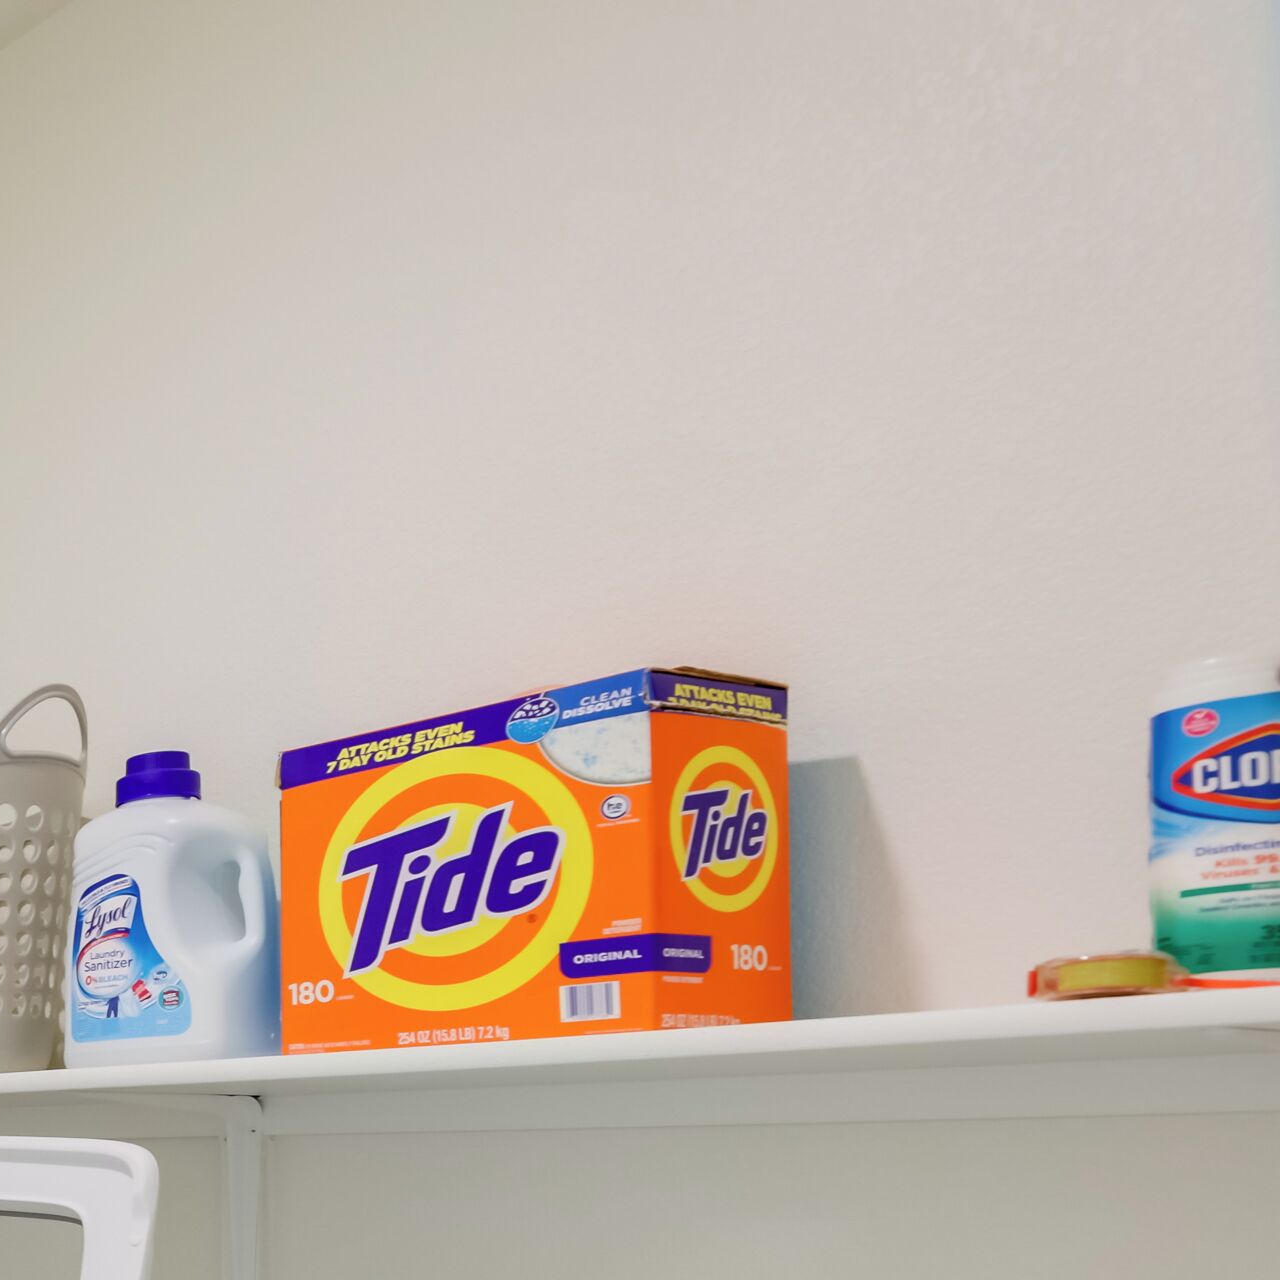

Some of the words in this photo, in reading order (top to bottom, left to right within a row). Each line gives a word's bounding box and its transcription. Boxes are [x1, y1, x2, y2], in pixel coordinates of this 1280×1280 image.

[562, 696, 632, 719] DISSOLVE
[580, 687, 633, 706] CLEAN
[675, 683, 735, 705] ATTACKS
[736, 692, 772, 710] EVEN
[325, 761, 337, 774] 7
[338, 754, 372, 771] DAY
[374, 747, 409, 762] OLD
[410, 730, 475, 754] STAINS
[336, 734, 412, 760] ATTACKS
[414, 722, 464, 743] EVEN
[681, 788, 768, 882] Tide
[341, 801, 566, 979] Tide
[84, 897, 132, 939] Lysol
[84, 957, 133, 973] Sanitizer
[90, 949, 126, 961] Laundry
[573, 949, 642, 965] ORIGINAL
[662, 948, 705, 959] ORIGINAL
[730, 944, 768, 971] 180
[288, 979, 335, 1005] 180
[398, 1031, 416, 1045] 254
[417, 1030, 431, 1043] OZ
[432, 1028, 457, 1044] (15.8
[458, 1026, 476, 1042] LB)
[477, 1026, 494, 1040] 7.2
[495, 1025, 510, 1040] kg
